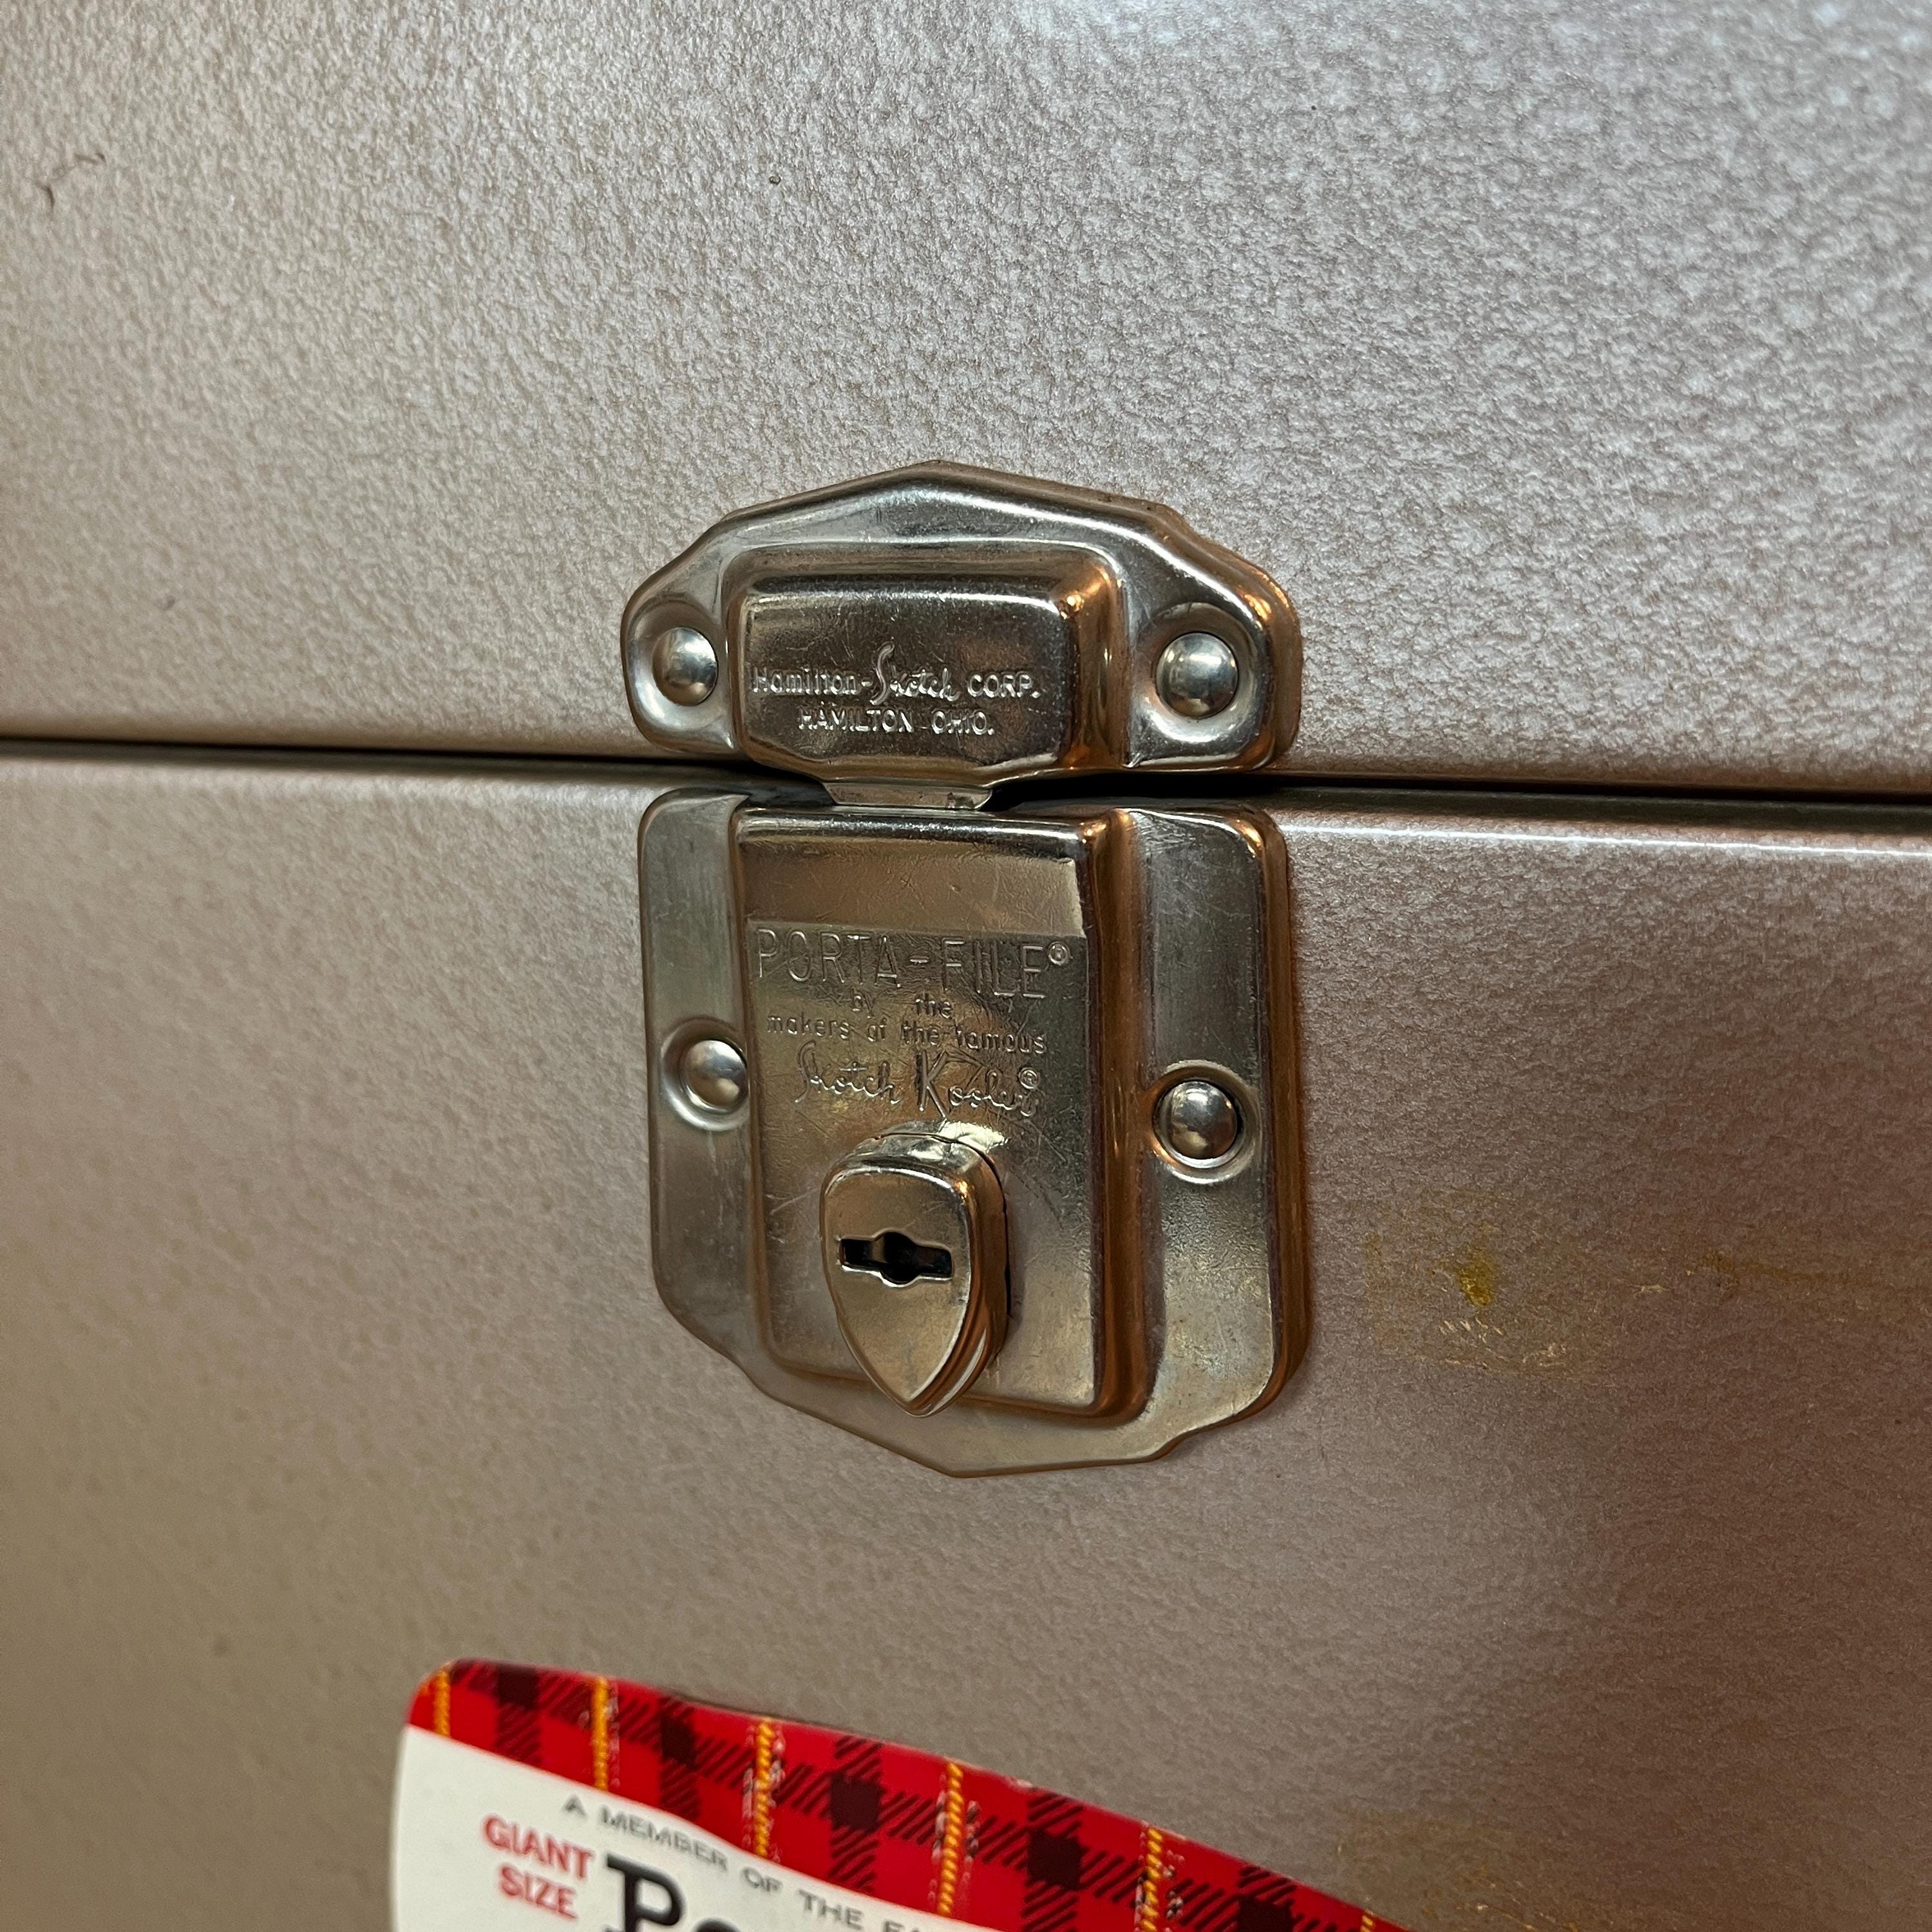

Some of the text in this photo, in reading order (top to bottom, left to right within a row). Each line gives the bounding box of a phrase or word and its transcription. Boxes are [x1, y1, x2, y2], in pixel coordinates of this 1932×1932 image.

[967, 672, 1041, 699] CORP.
[851, 986, 953, 1019] by the
[766, 1011, 1046, 1054] makers of the famous
[481, 1814, 594, 1880] GIANT
[561, 1794, 587, 1819] A
[599, 1804, 729, 1870] MEMBER
[742, 1866, 782, 1893] OF
[798, 1888, 864, 1931] THE
[498, 1862, 578, 1921] SIZE
